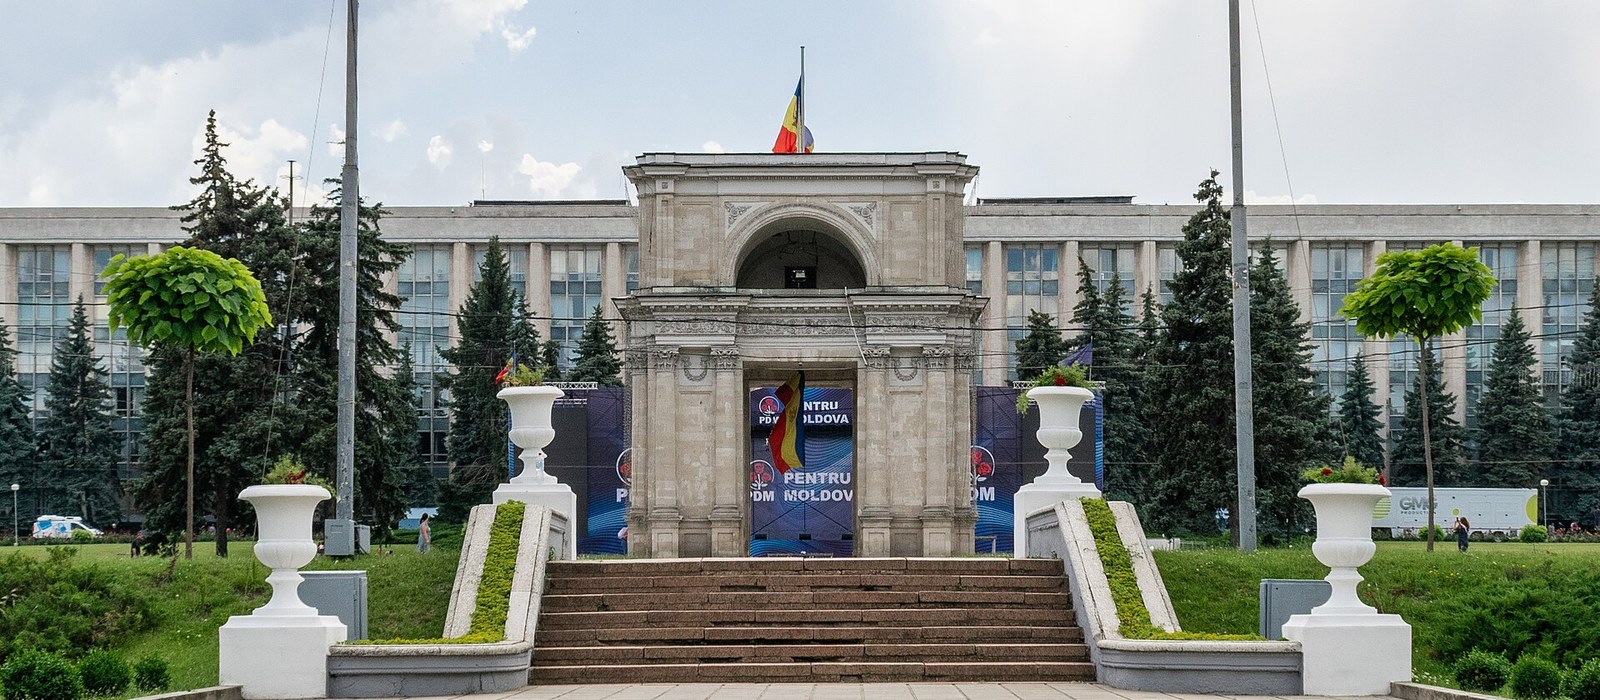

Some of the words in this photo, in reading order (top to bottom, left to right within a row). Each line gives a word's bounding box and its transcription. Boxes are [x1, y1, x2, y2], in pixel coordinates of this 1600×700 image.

[803, 401, 838, 411] NTRU
[783, 472, 851, 485] PENTRU
[784, 489, 853, 502] MOLDOV
